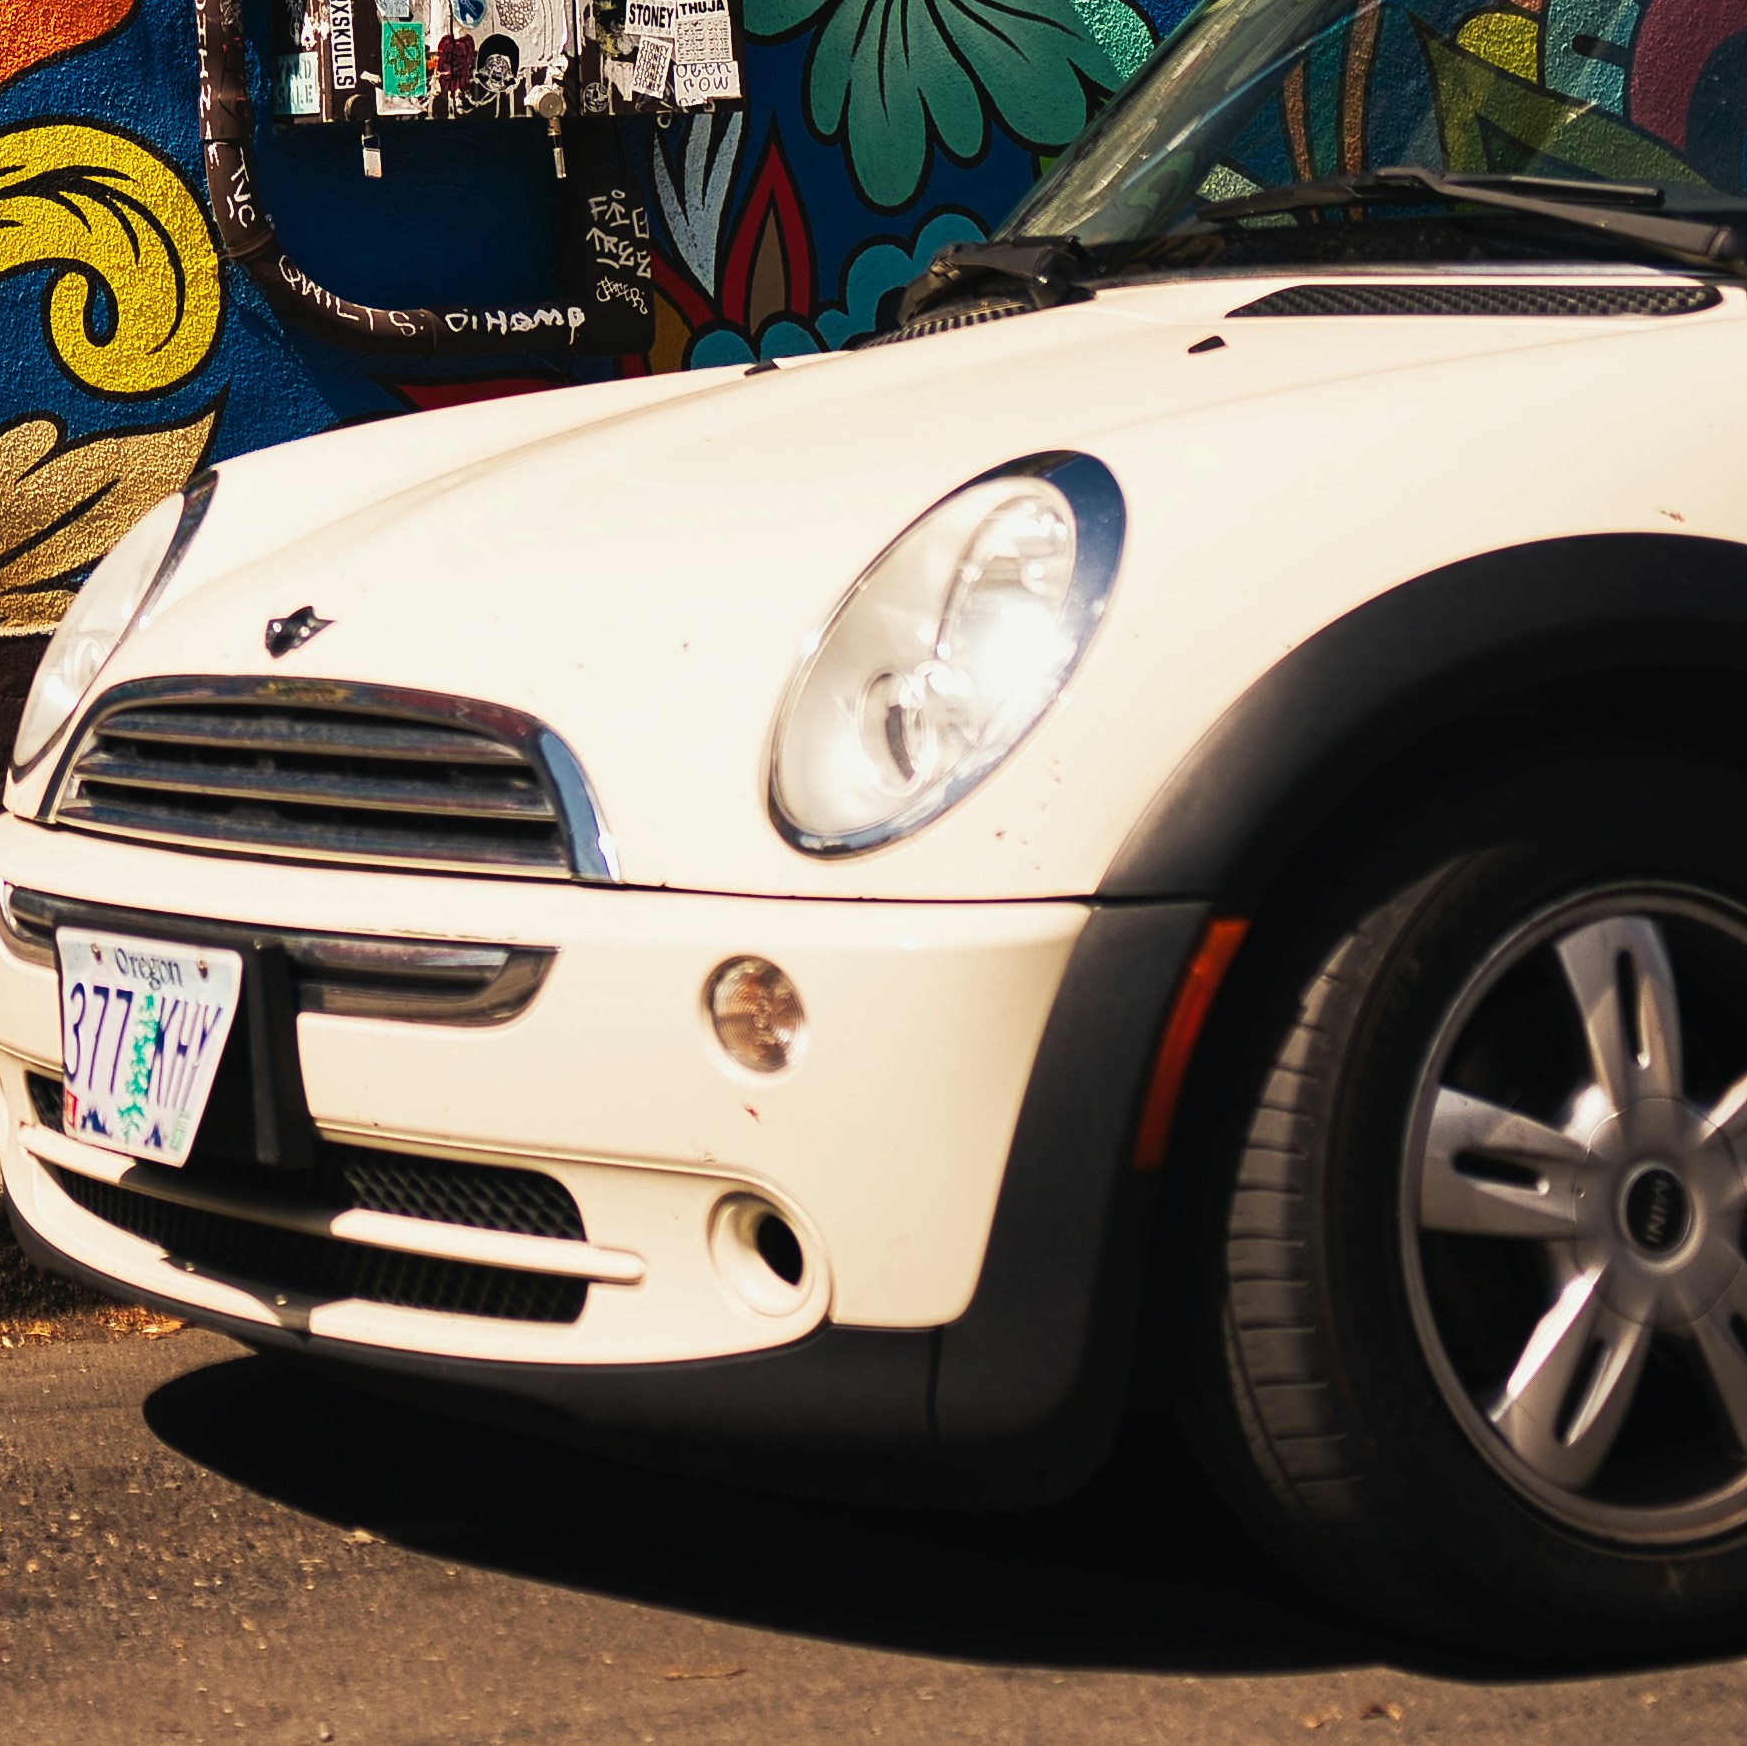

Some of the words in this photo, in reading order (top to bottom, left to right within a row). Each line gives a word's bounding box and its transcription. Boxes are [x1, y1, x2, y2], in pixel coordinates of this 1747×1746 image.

[628, 3, 674, 29] STONEY
[114, 947, 185, 991] Oregon
[64, 982, 134, 1096] 377
